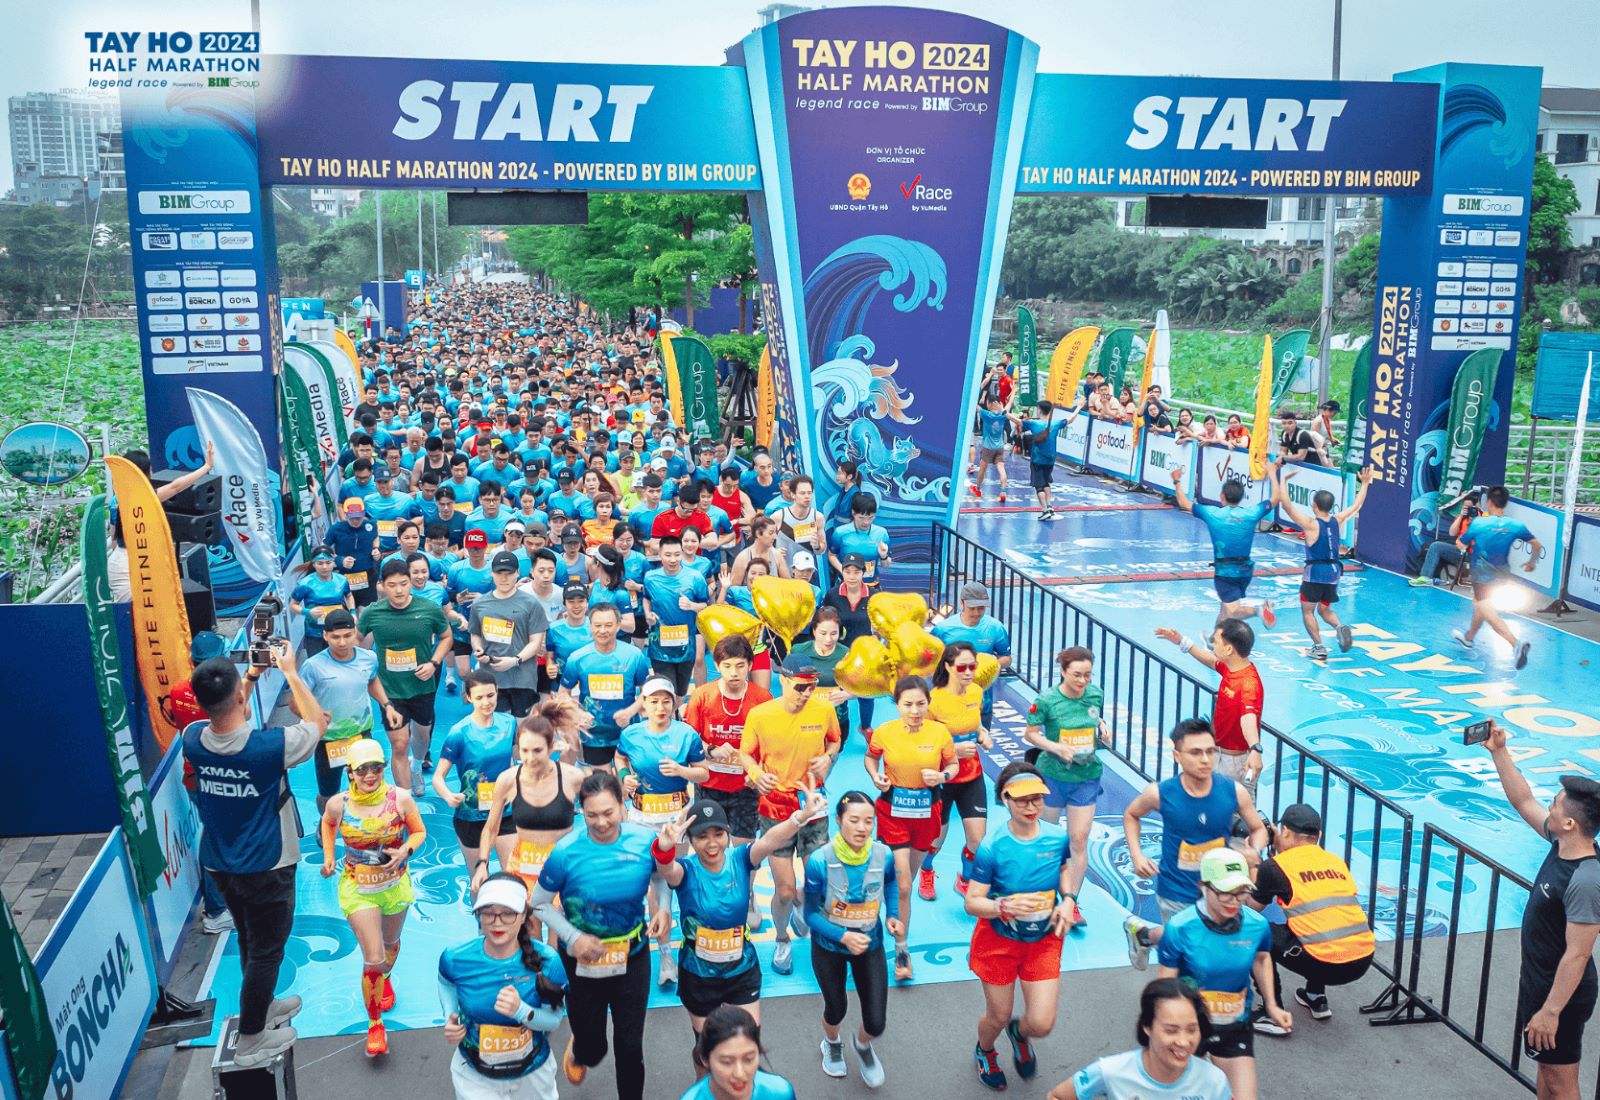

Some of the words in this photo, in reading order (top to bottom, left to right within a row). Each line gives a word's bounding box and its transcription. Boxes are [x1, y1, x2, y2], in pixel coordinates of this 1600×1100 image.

[792, 38, 858, 68] TAY
[864, 40, 916, 70] HO
[928, 46, 986, 68] 2024
[797, 73, 853, 91] HALF
[862, 74, 989, 95] MARATHON
[392, 79, 655, 143] START
[795, 97, 843, 111] legend
[847, 99, 880, 110] race
[922, 97, 988, 115] BIMGroup
[1125, 95, 1348, 152] START
[280, 157, 312, 177] TAY
[318, 158, 342, 178] HO
[347, 159, 391, 178] HALF
[396, 160, 493, 180] MARATHON
[498, 162, 539, 181] 2024
[554, 162, 637, 181] POWERED
[642, 163, 663, 182] BY
[667, 163, 697, 182] BIM
[702, 163, 757, 182] GROUP
[877, 156, 915, 164] ORGANIZER
[1022, 167, 1049, 184] TAY
[1053, 167, 1073, 185] HO
[1077, 167, 1115, 185] HALF
[1119, 168, 1200, 186] MARATHON
[1204, 169, 1237, 187] 2024
[1251, 170, 1320, 187] POWERED
[1324, 170, 1341, 187] BY
[1345, 170, 1370, 187] BIM
[1374, 170, 1421, 187] GROUP
[158, 194, 234, 212] BIMGroup
[1381, 291, 1397, 352] 2024
[1391, 287, 1412, 418] MARATHON
[1374, 363, 1392, 414] HO
[1368, 422, 1388, 484] TAY
[1385, 428, 1399, 483] HALF
[1400, 438, 1410, 487] legend
[134, 506, 154, 609] FITNESS
[147, 622, 168, 686] ELITE
[1324, 623, 1484, 675] TAY
[1439, 682, 1600, 738] HO
[198, 766, 251, 780] XMAX
[199, 780, 260, 797] MEDIA
[480, 791, 493, 799] C1
[894, 796, 916, 806] PACER
[1299, 869, 1347, 884] Media
[70, 976, 87, 1006] Ong
[51, 932, 134, 1100] BONCHA
